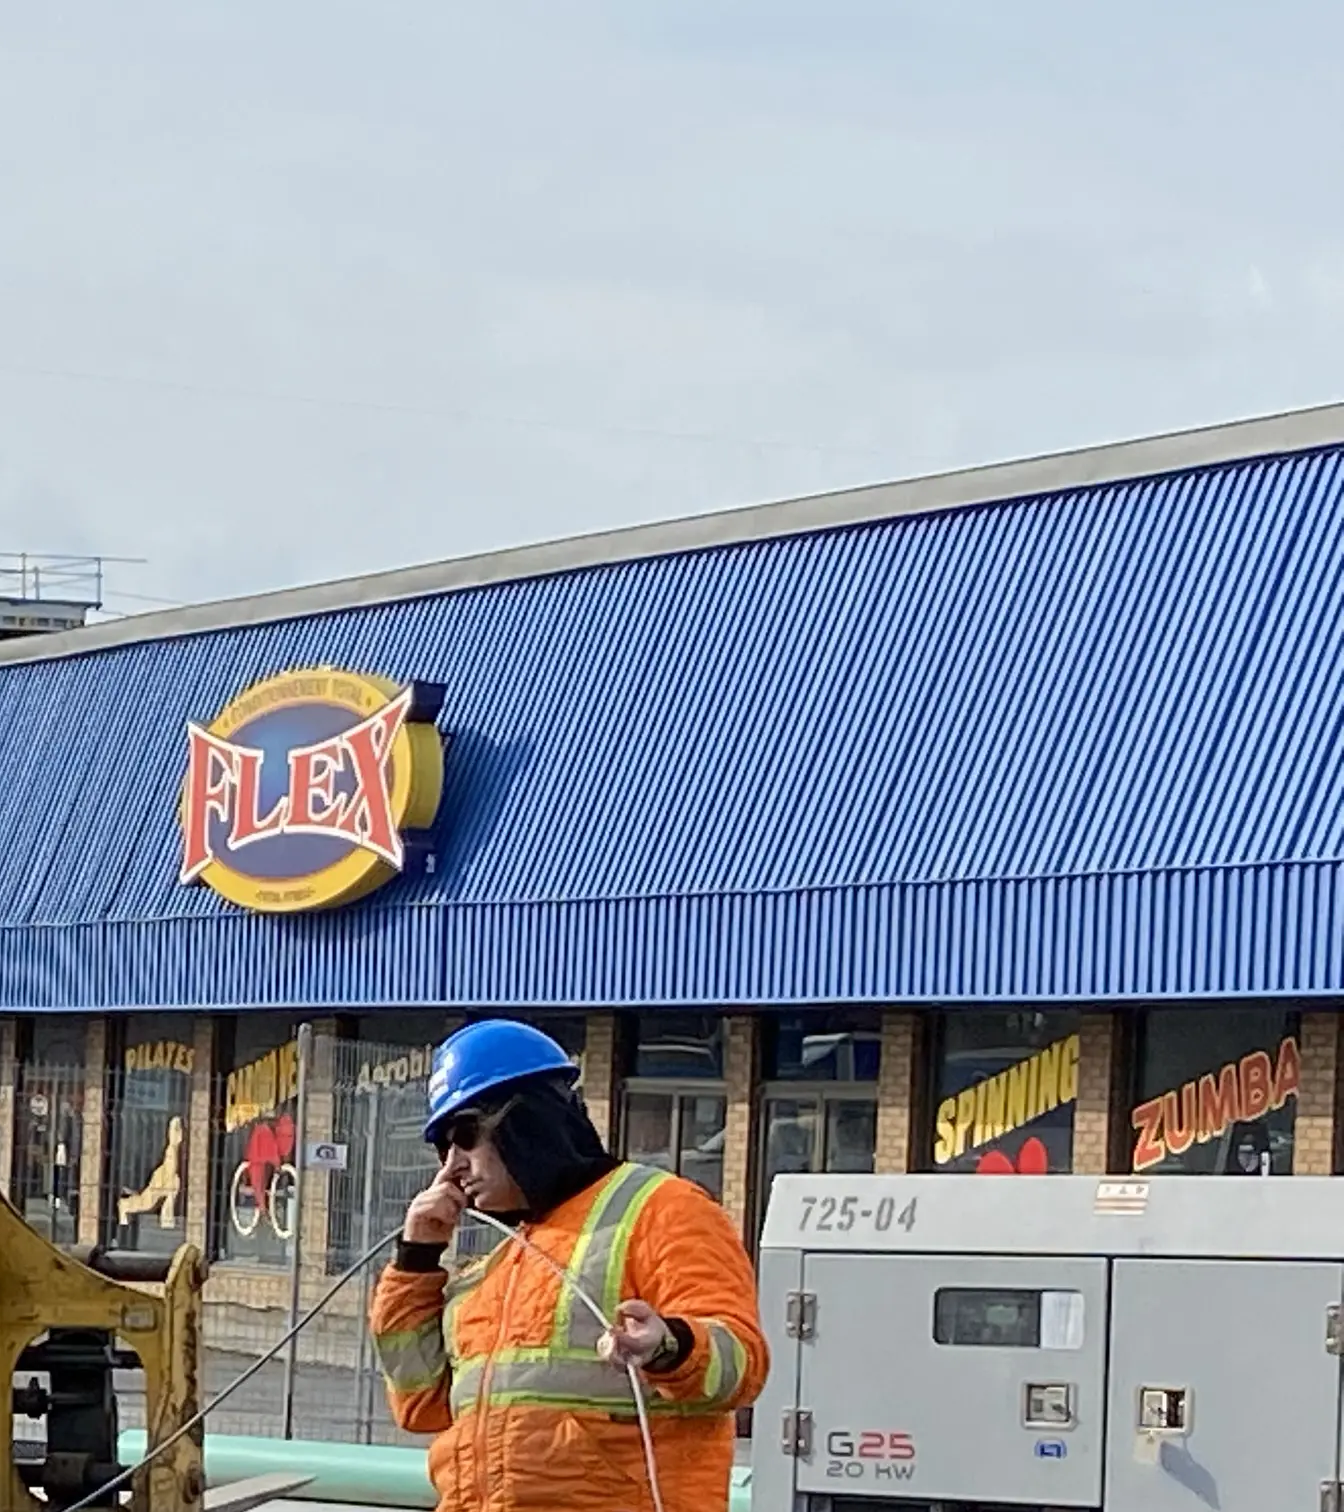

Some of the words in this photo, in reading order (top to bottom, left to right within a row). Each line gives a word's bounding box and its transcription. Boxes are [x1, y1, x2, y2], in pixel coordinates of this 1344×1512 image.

[180, 684, 413, 884] FLEX
[125, 1041, 195, 1076] PILATES
[934, 1034, 1080, 1165] SPINNING
[1131, 1036, 1302, 1170] ZUMBA
[798, 1196, 918, 1232] 725-04
[827, 1431, 915, 1459] G25
[826, 1460, 864, 1478] 20
